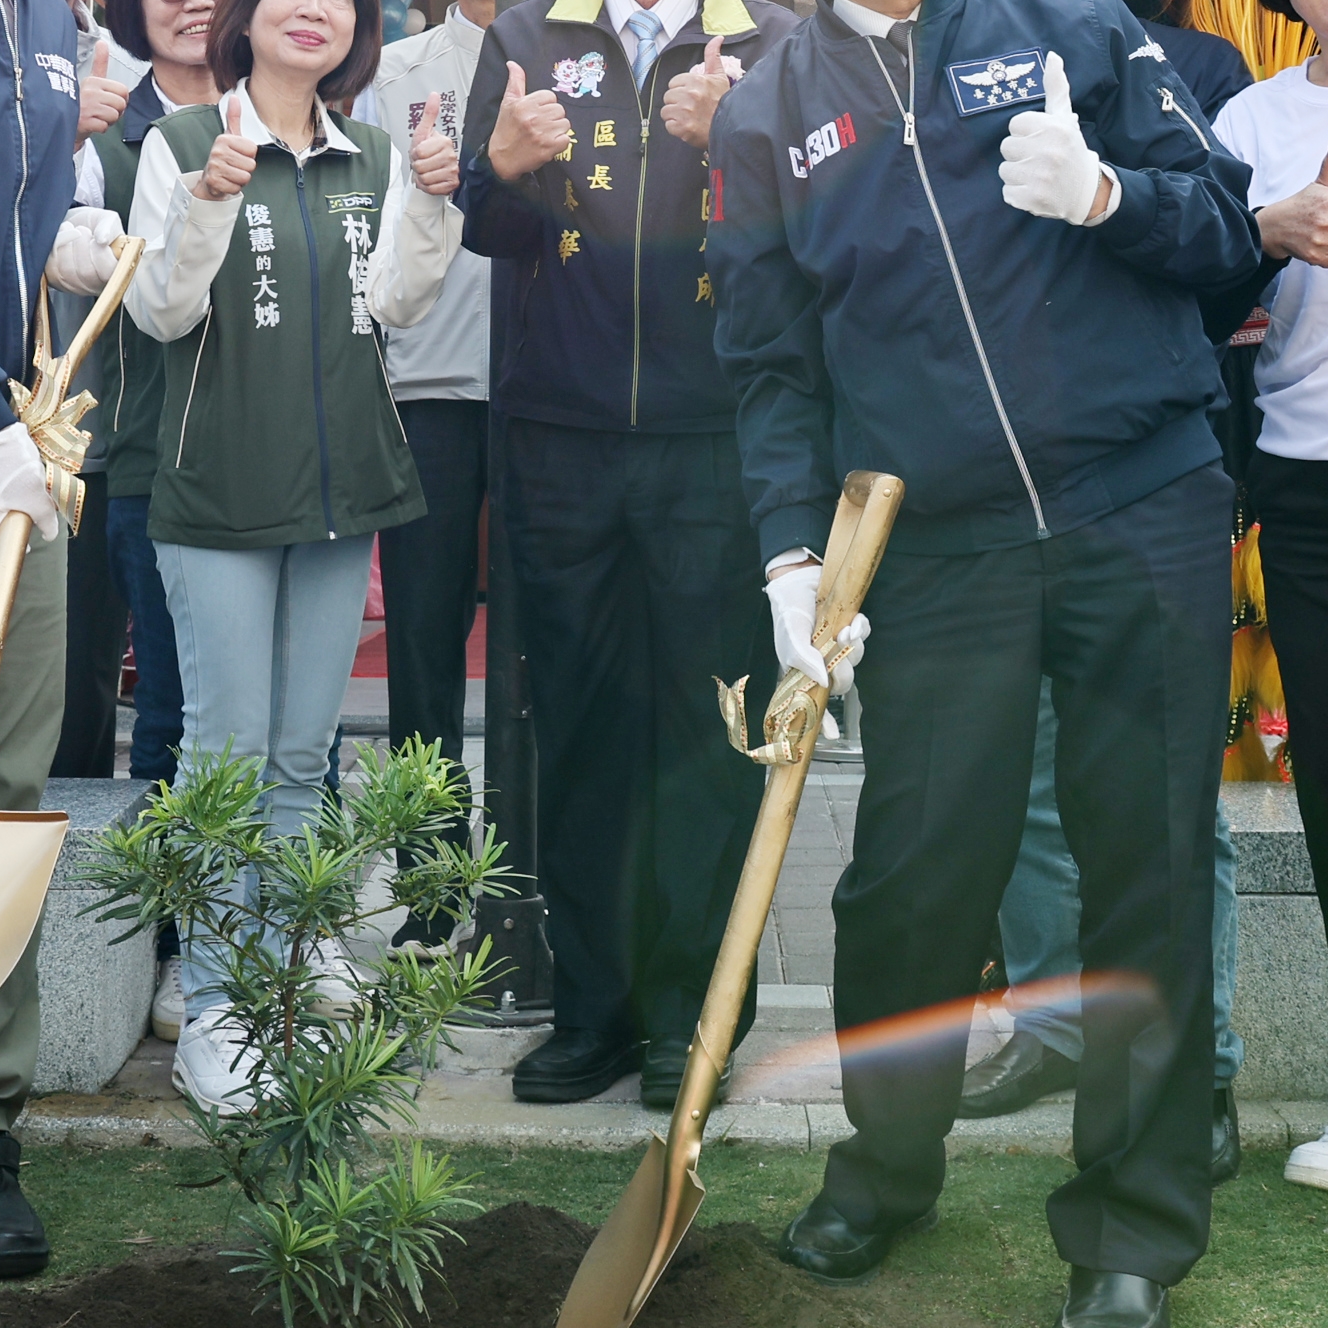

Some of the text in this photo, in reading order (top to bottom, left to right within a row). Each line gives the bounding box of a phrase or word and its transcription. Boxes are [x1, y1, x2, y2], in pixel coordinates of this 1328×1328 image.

[586, 119, 618, 191] 區長
[342, 196, 373, 208] DPP
[244, 203, 281, 329] 俊憲的大姊
